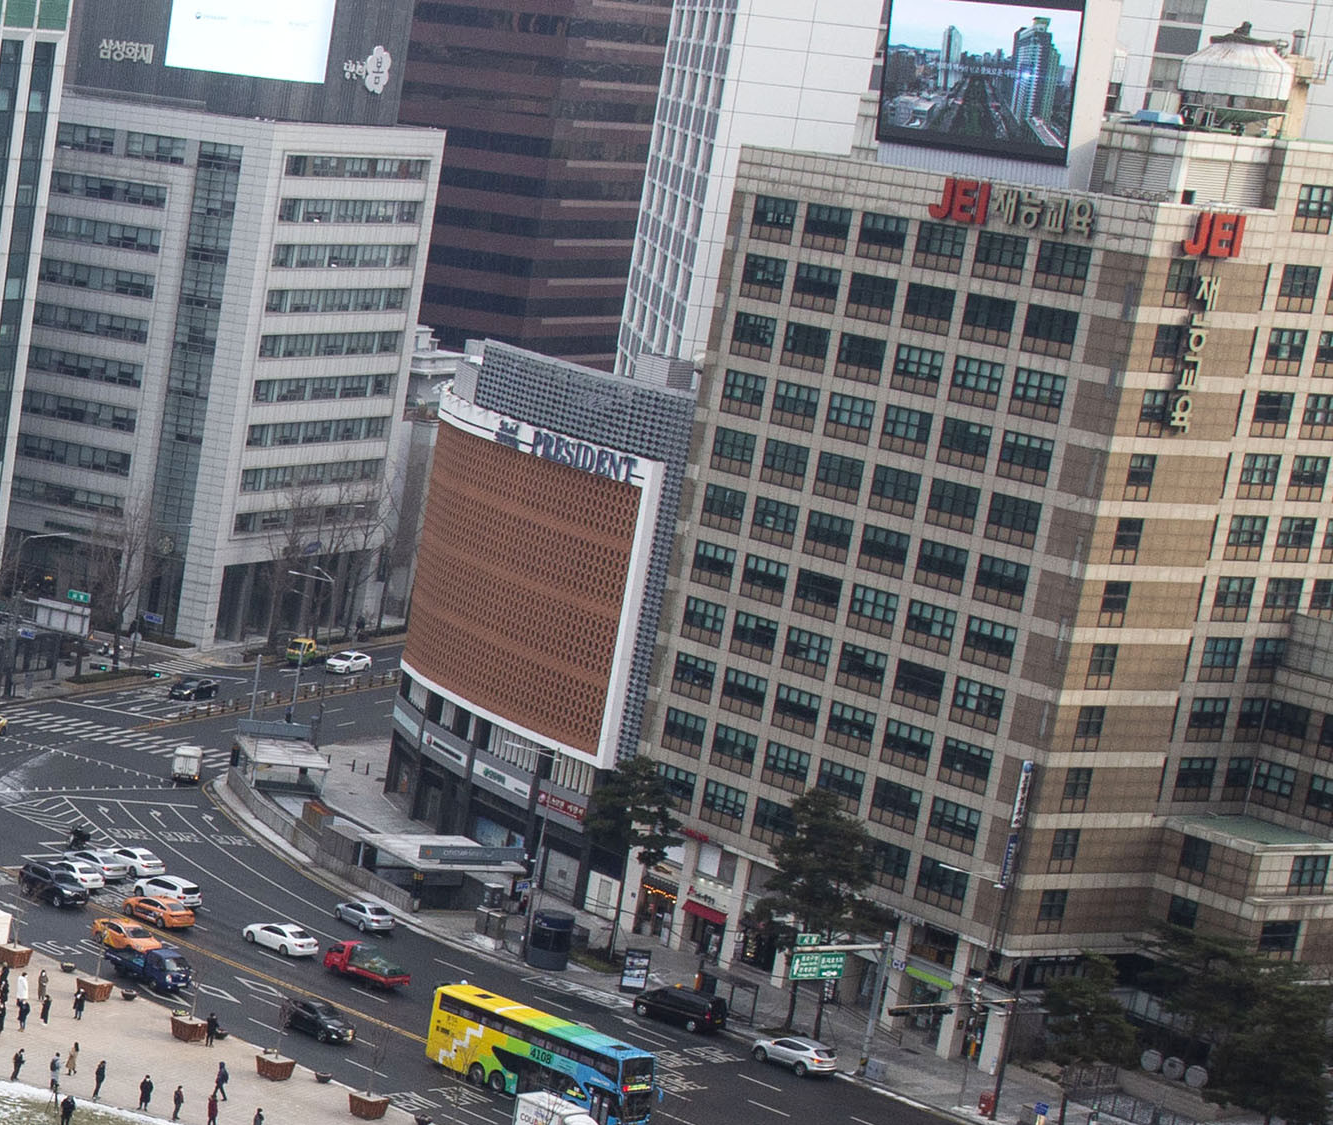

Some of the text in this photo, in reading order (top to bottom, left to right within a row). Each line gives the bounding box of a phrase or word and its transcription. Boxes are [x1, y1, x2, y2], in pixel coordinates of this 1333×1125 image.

[99, 38, 154, 65] 삼성화재
[928, 176, 1096, 240] JEI 재능교육
[1182, 211, 1247, 258] JEI
[1171, 275, 1222, 433] 재능교육
[531, 430, 638, 484] PRESIDENT
[892, 960, 907, 971] CU
[531, 1048, 554, 1065] 4108
